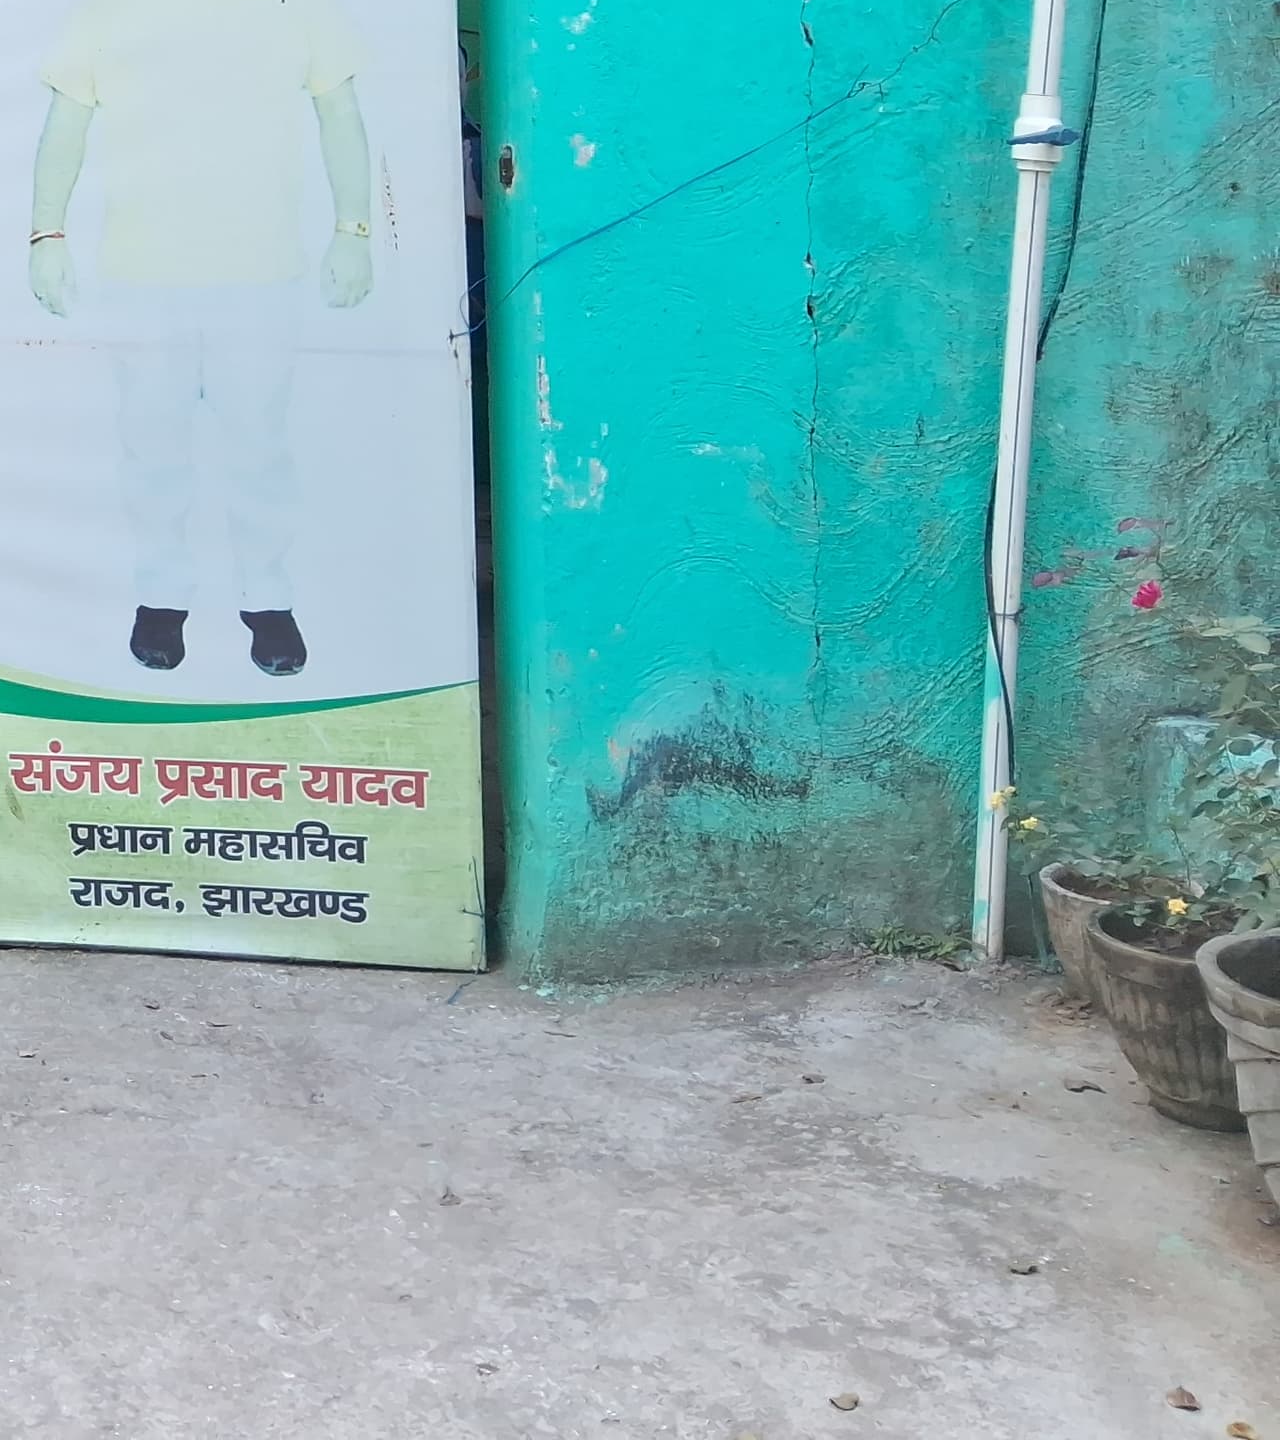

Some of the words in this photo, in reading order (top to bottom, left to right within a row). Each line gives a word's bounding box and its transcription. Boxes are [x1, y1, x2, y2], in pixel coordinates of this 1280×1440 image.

[9, 740, 142, 795] संजय
[154, 759, 287, 804] प्रसाद
[299, 765, 429, 809] यादव
[68, 822, 173, 856] प्रधान
[182, 821, 369, 864] महासचिव
[69, 877, 185, 913] राजद,
[199, 883, 370, 924] झारखण्ड
